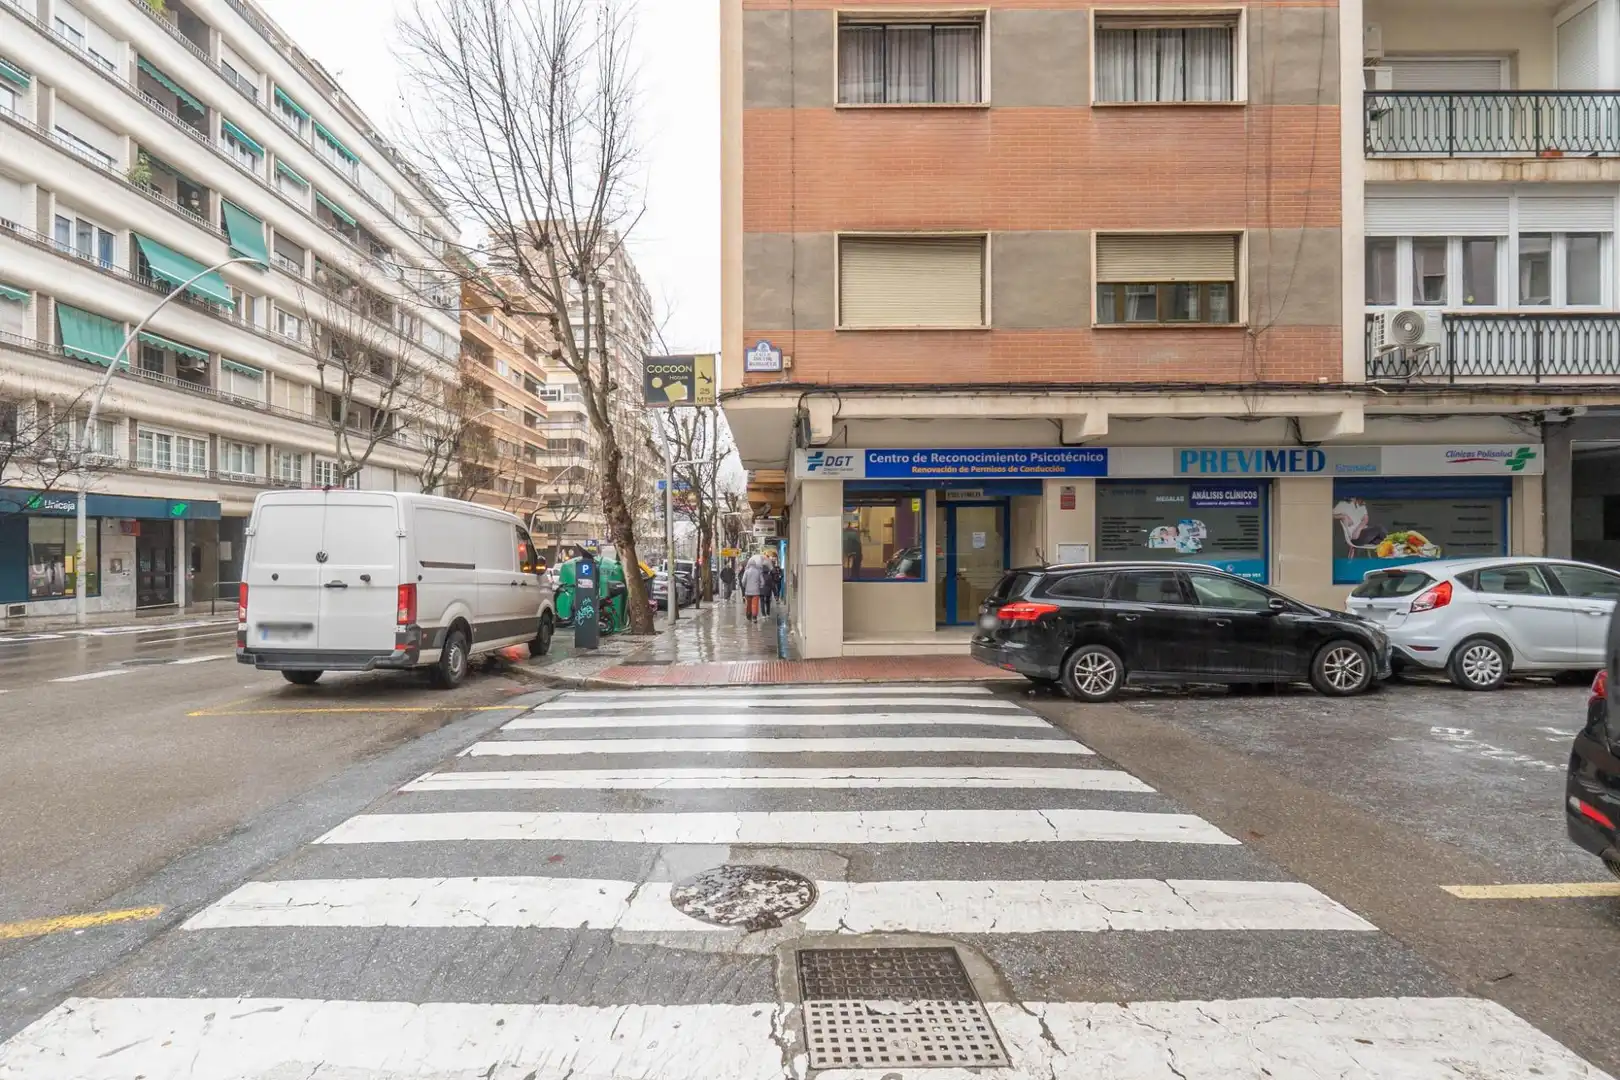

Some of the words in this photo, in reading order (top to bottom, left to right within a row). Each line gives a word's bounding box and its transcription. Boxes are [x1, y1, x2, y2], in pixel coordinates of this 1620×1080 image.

[646, 364, 692, 373] COCOON
[699, 387, 711, 395] 25
[869, 453, 909, 463] Centro
[912, 453, 928, 463] de
[931, 452, 1027, 463] Reconocimiento
[1030, 451, 1104, 463] Psicotécnico
[1445, 450, 1477, 458] Clínicas
[1476, 450, 1513, 458] Polisalud
[824, 455, 854, 467] DGT
[1180, 449, 1326, 473] PREVIMED
[911, 465, 957, 474] Renovación
[1020, 465, 1065, 473] Conducción
[1191, 489, 1224, 500] ANÁLISIS
[1225, 488, 1258, 500] CLÍNICOS
[44, 499, 76, 512] Unicaja
[582, 564, 589, 574] P
